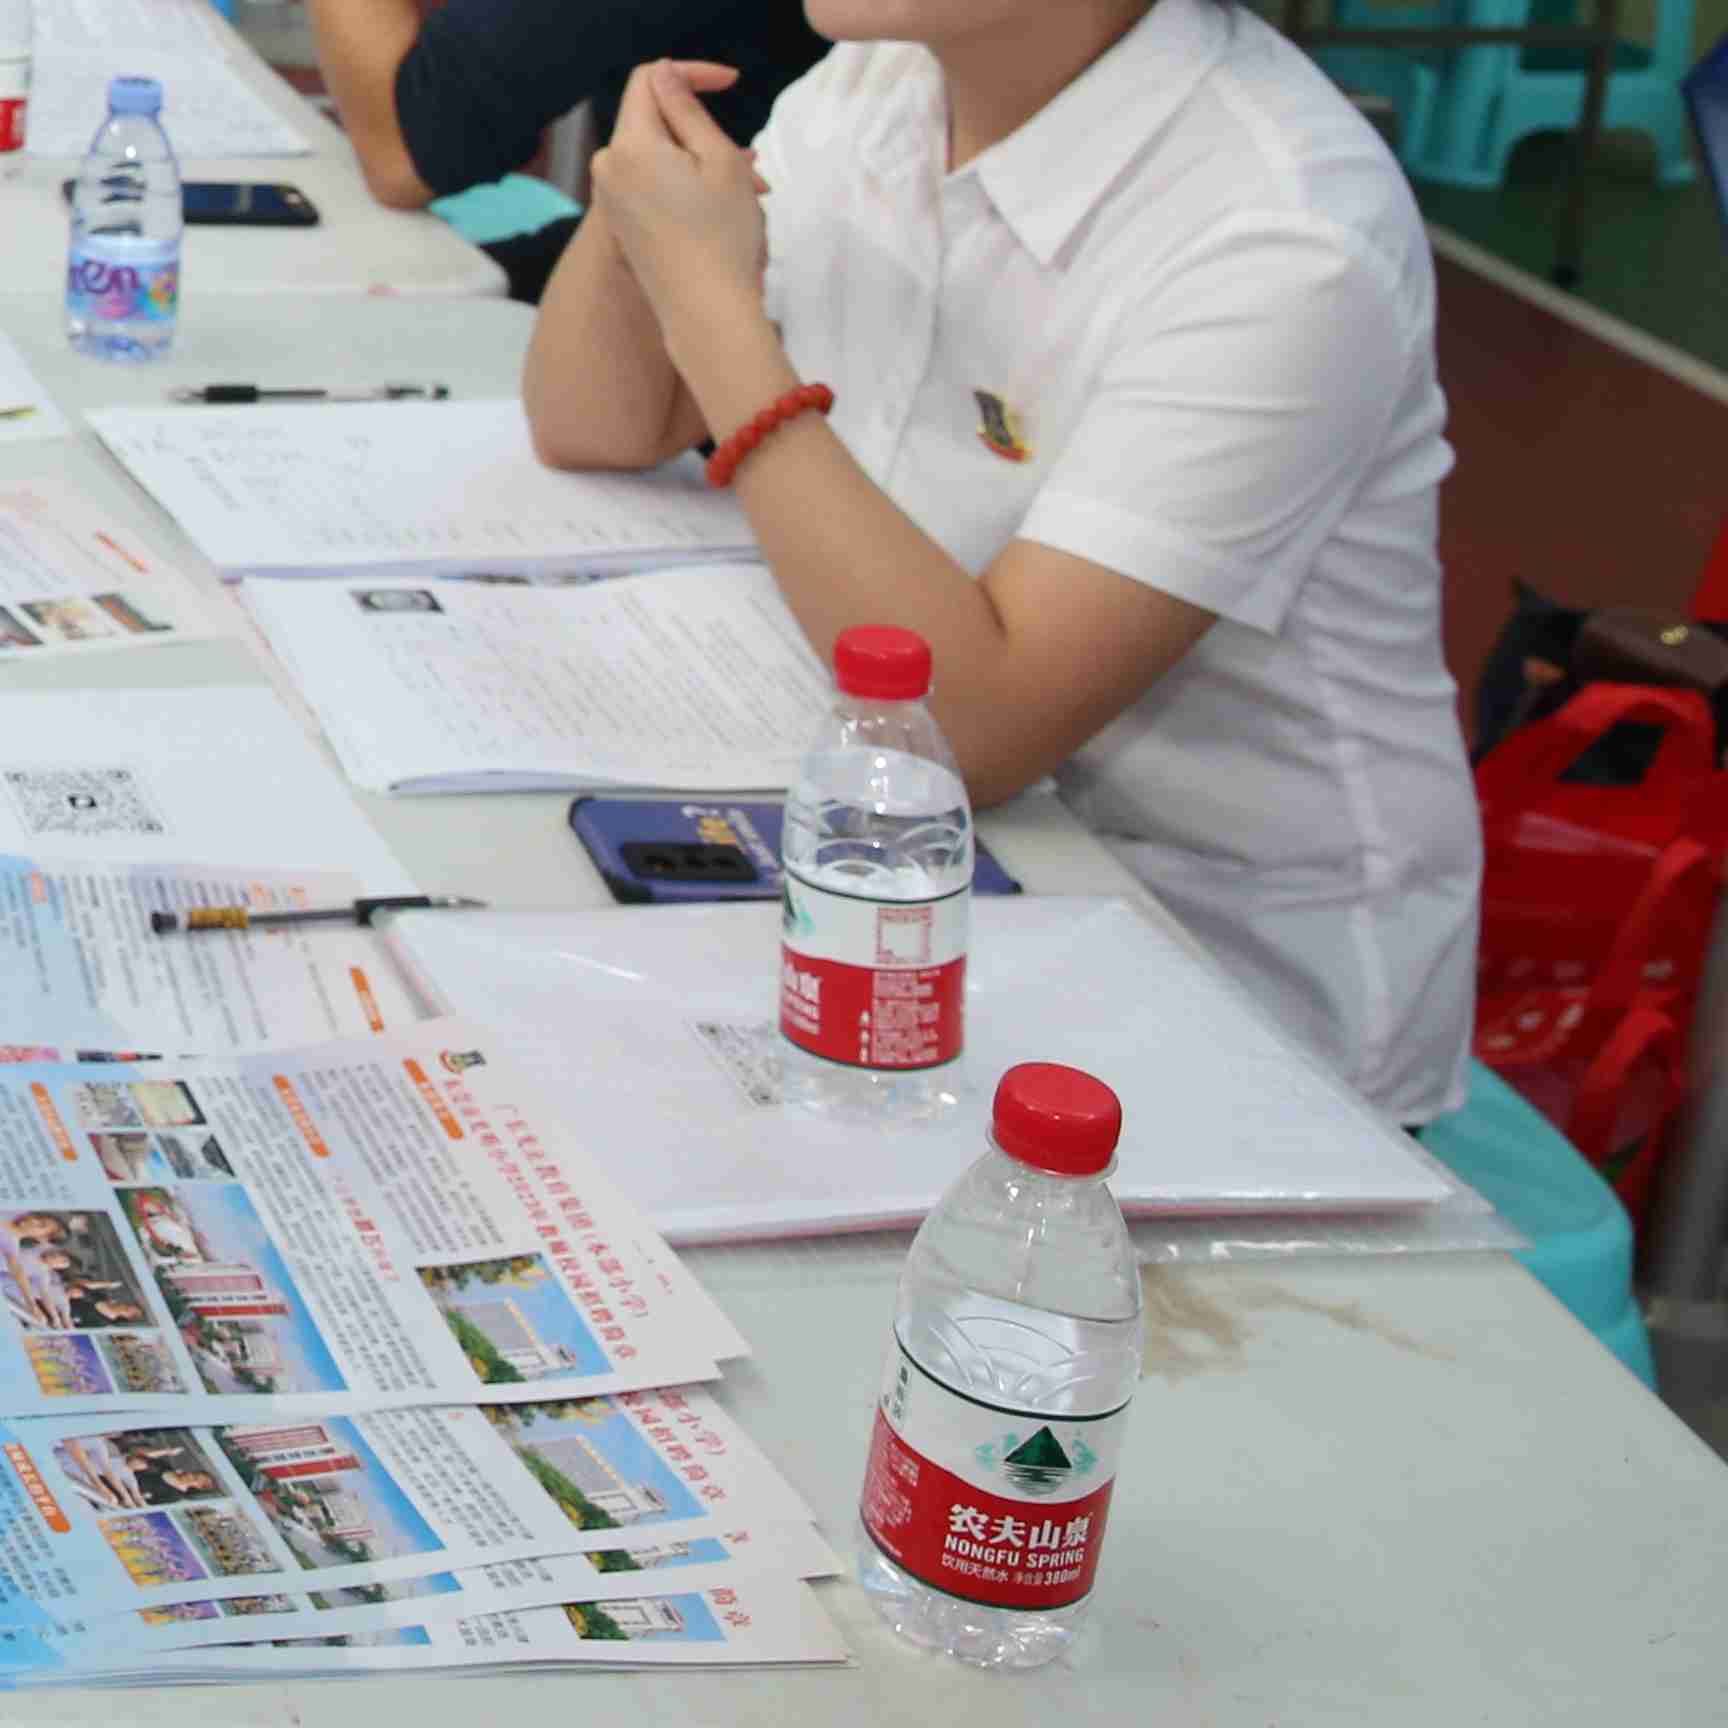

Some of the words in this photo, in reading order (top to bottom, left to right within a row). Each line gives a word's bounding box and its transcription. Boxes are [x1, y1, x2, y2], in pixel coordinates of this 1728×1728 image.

[946, 1503, 1090, 1550] 农夫山泉
[944, 1534, 1020, 1568] NONGFU
[1026, 1546, 1085, 1570] SPRING
